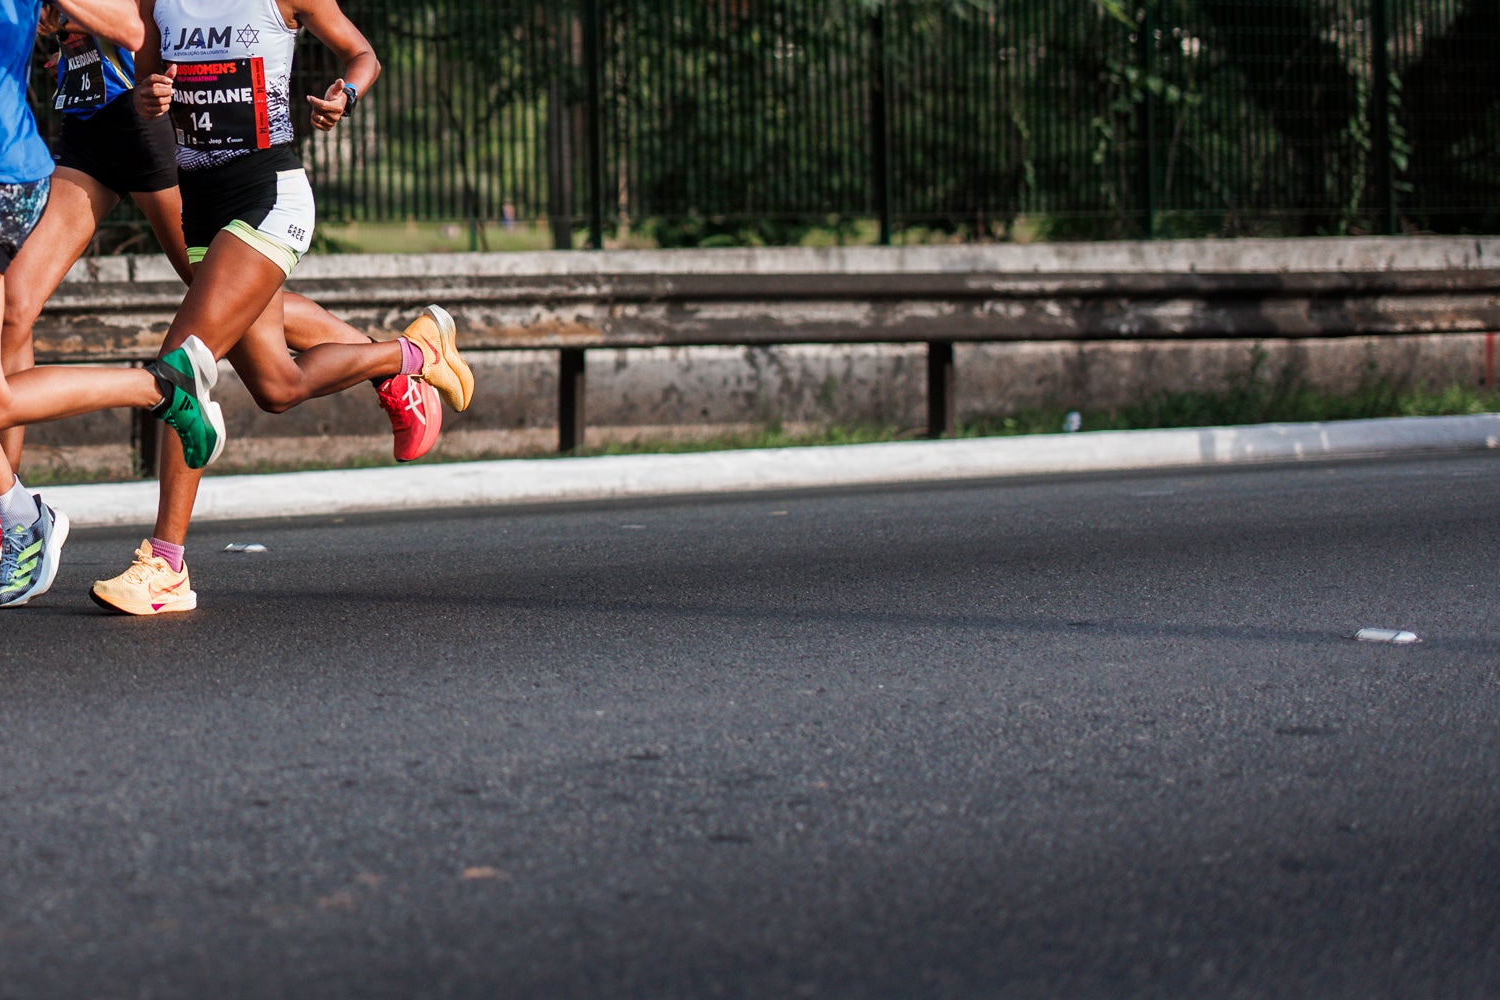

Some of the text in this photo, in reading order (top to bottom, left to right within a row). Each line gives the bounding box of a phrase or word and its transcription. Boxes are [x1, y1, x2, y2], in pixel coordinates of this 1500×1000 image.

[174, 26, 232, 51] JAM
[81, 72, 91, 91] 16
[173, 87, 253, 105] RANCIANE
[190, 111, 213, 131] 14
